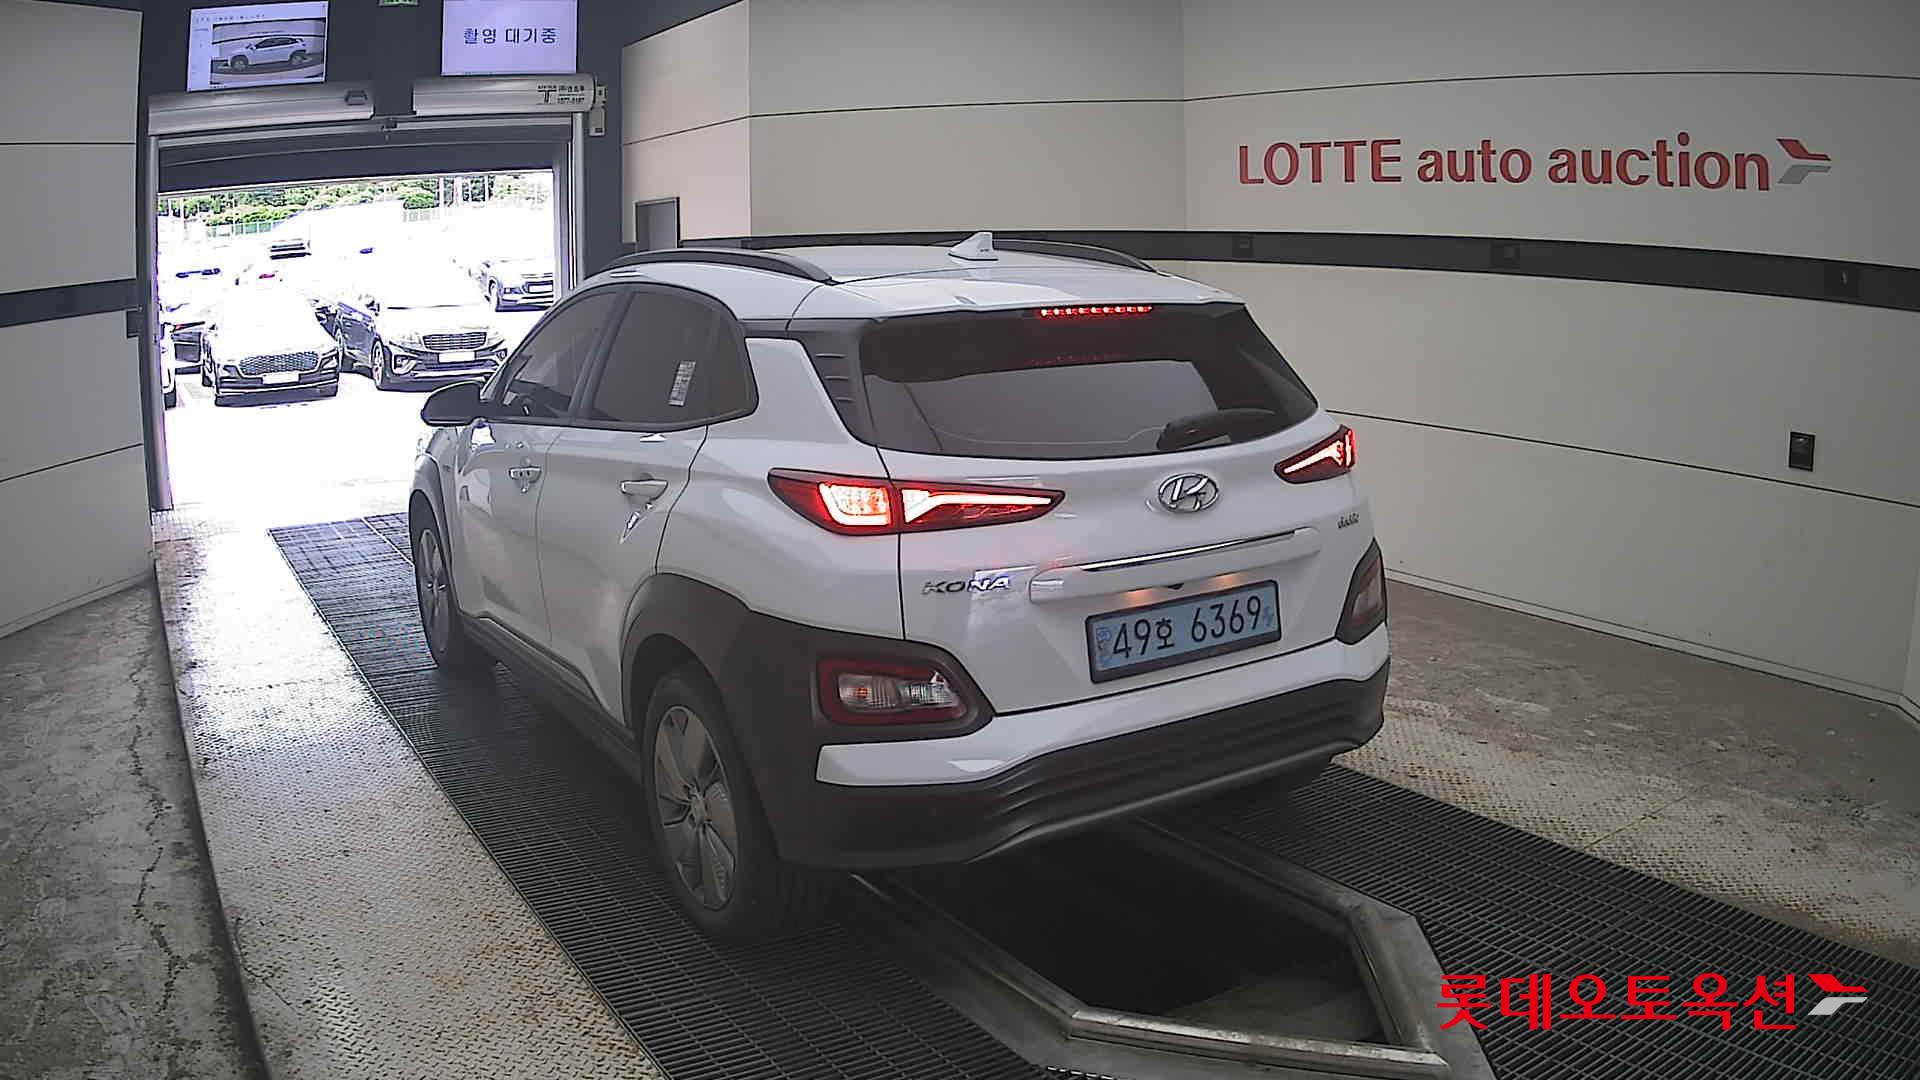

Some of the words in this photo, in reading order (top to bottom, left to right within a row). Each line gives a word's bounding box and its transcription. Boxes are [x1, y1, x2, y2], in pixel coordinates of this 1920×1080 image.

[464, 27, 497, 45] 촬영
[505, 27, 557, 45] 대기중
[1238, 138, 1402, 186] LOTTE
[1417, 138, 1534, 185] auto
[1547, 131, 1770, 191] auction
[920, 575, 1009, 595] KONA
[1112, 618, 1176, 659] 49호
[1191, 595, 1262, 643] 6369
